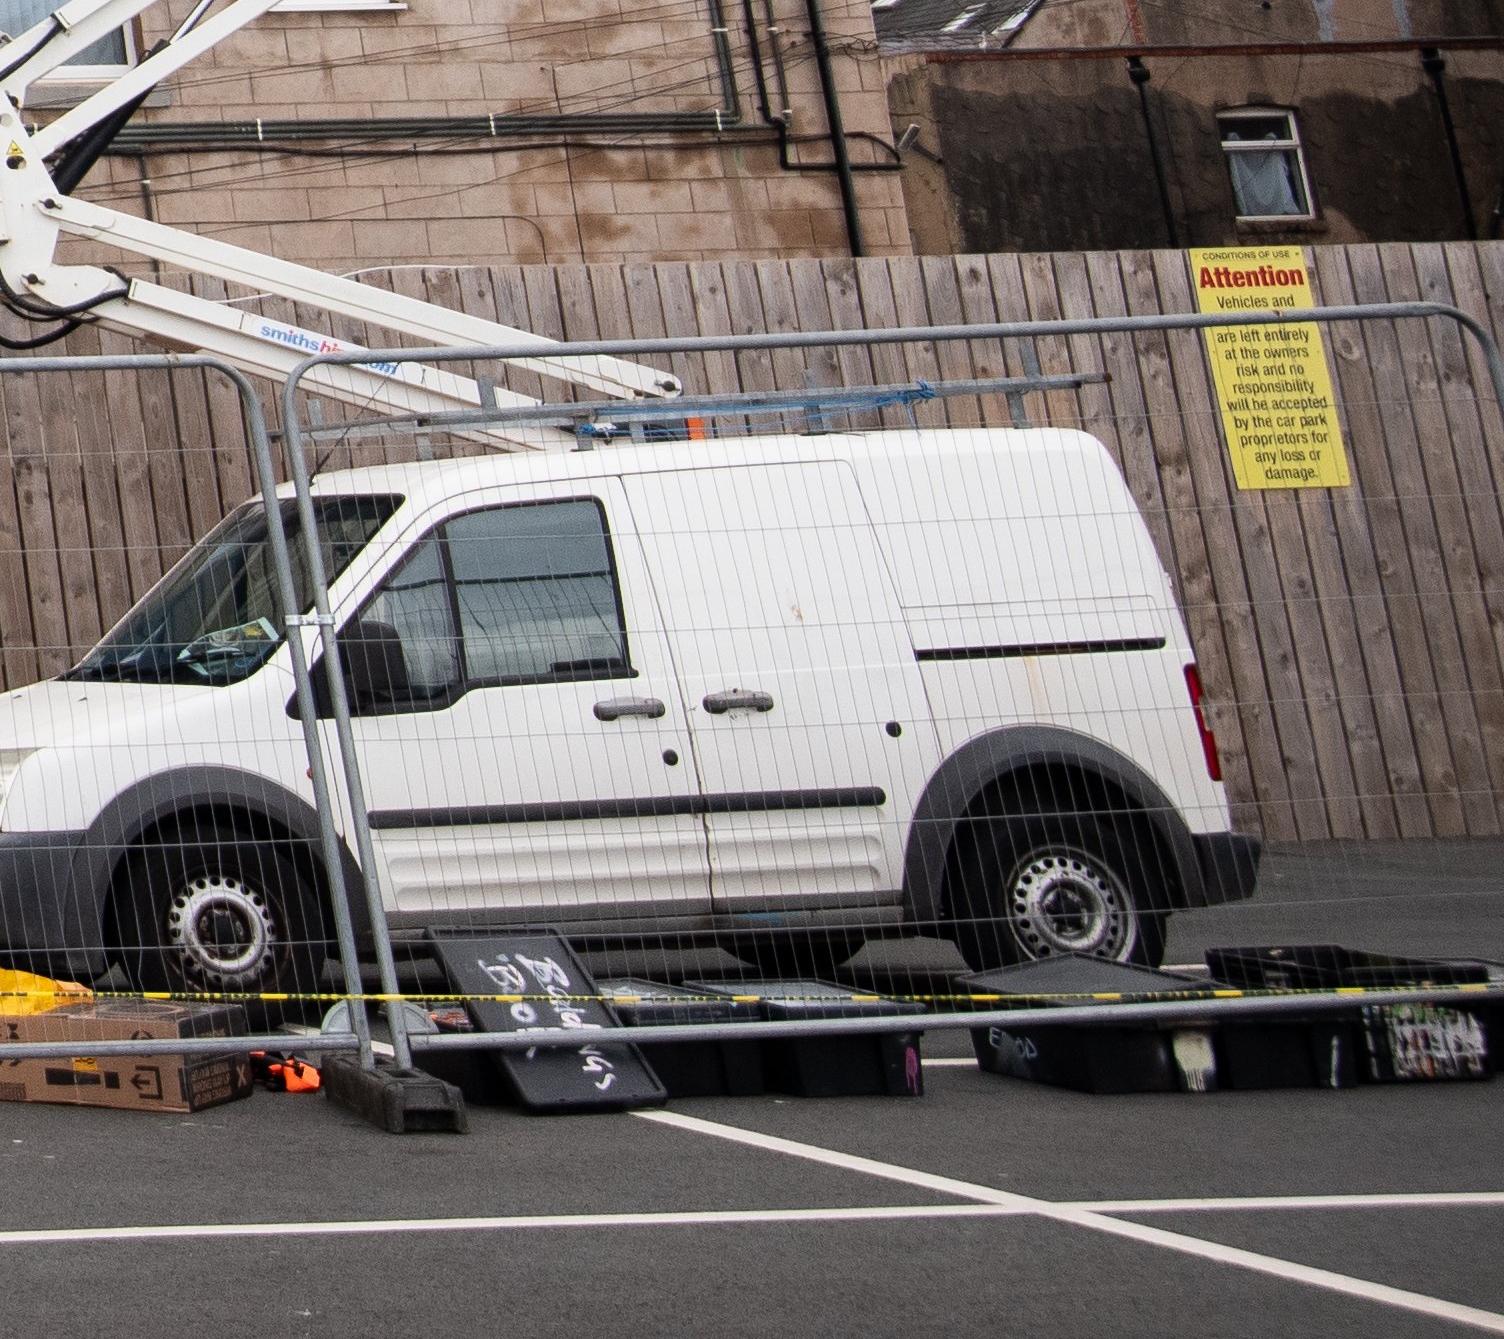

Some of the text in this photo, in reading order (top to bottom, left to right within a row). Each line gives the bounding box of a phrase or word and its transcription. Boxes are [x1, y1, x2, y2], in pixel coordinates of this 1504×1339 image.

[1202, 250, 1289, 260] CONDITIONS OF USE
[1199, 265, 1304, 288] Attention
[1217, 295, 1294, 309] Vehicles and
[1217, 328, 1309, 343] are left entirely
[1224, 346, 1309, 360] at the owners
[1236, 362, 1304, 377] risk and no
[1233, 379, 1314, 396] responsibility
[1227, 395, 1328, 412] will be accepted
[1235, 413, 1327, 429] by the car park
[1240, 431, 1328, 447] proprietors for
[1255, 448, 1321, 464] any loss or
[1265, 464, 1318, 480] damage.
